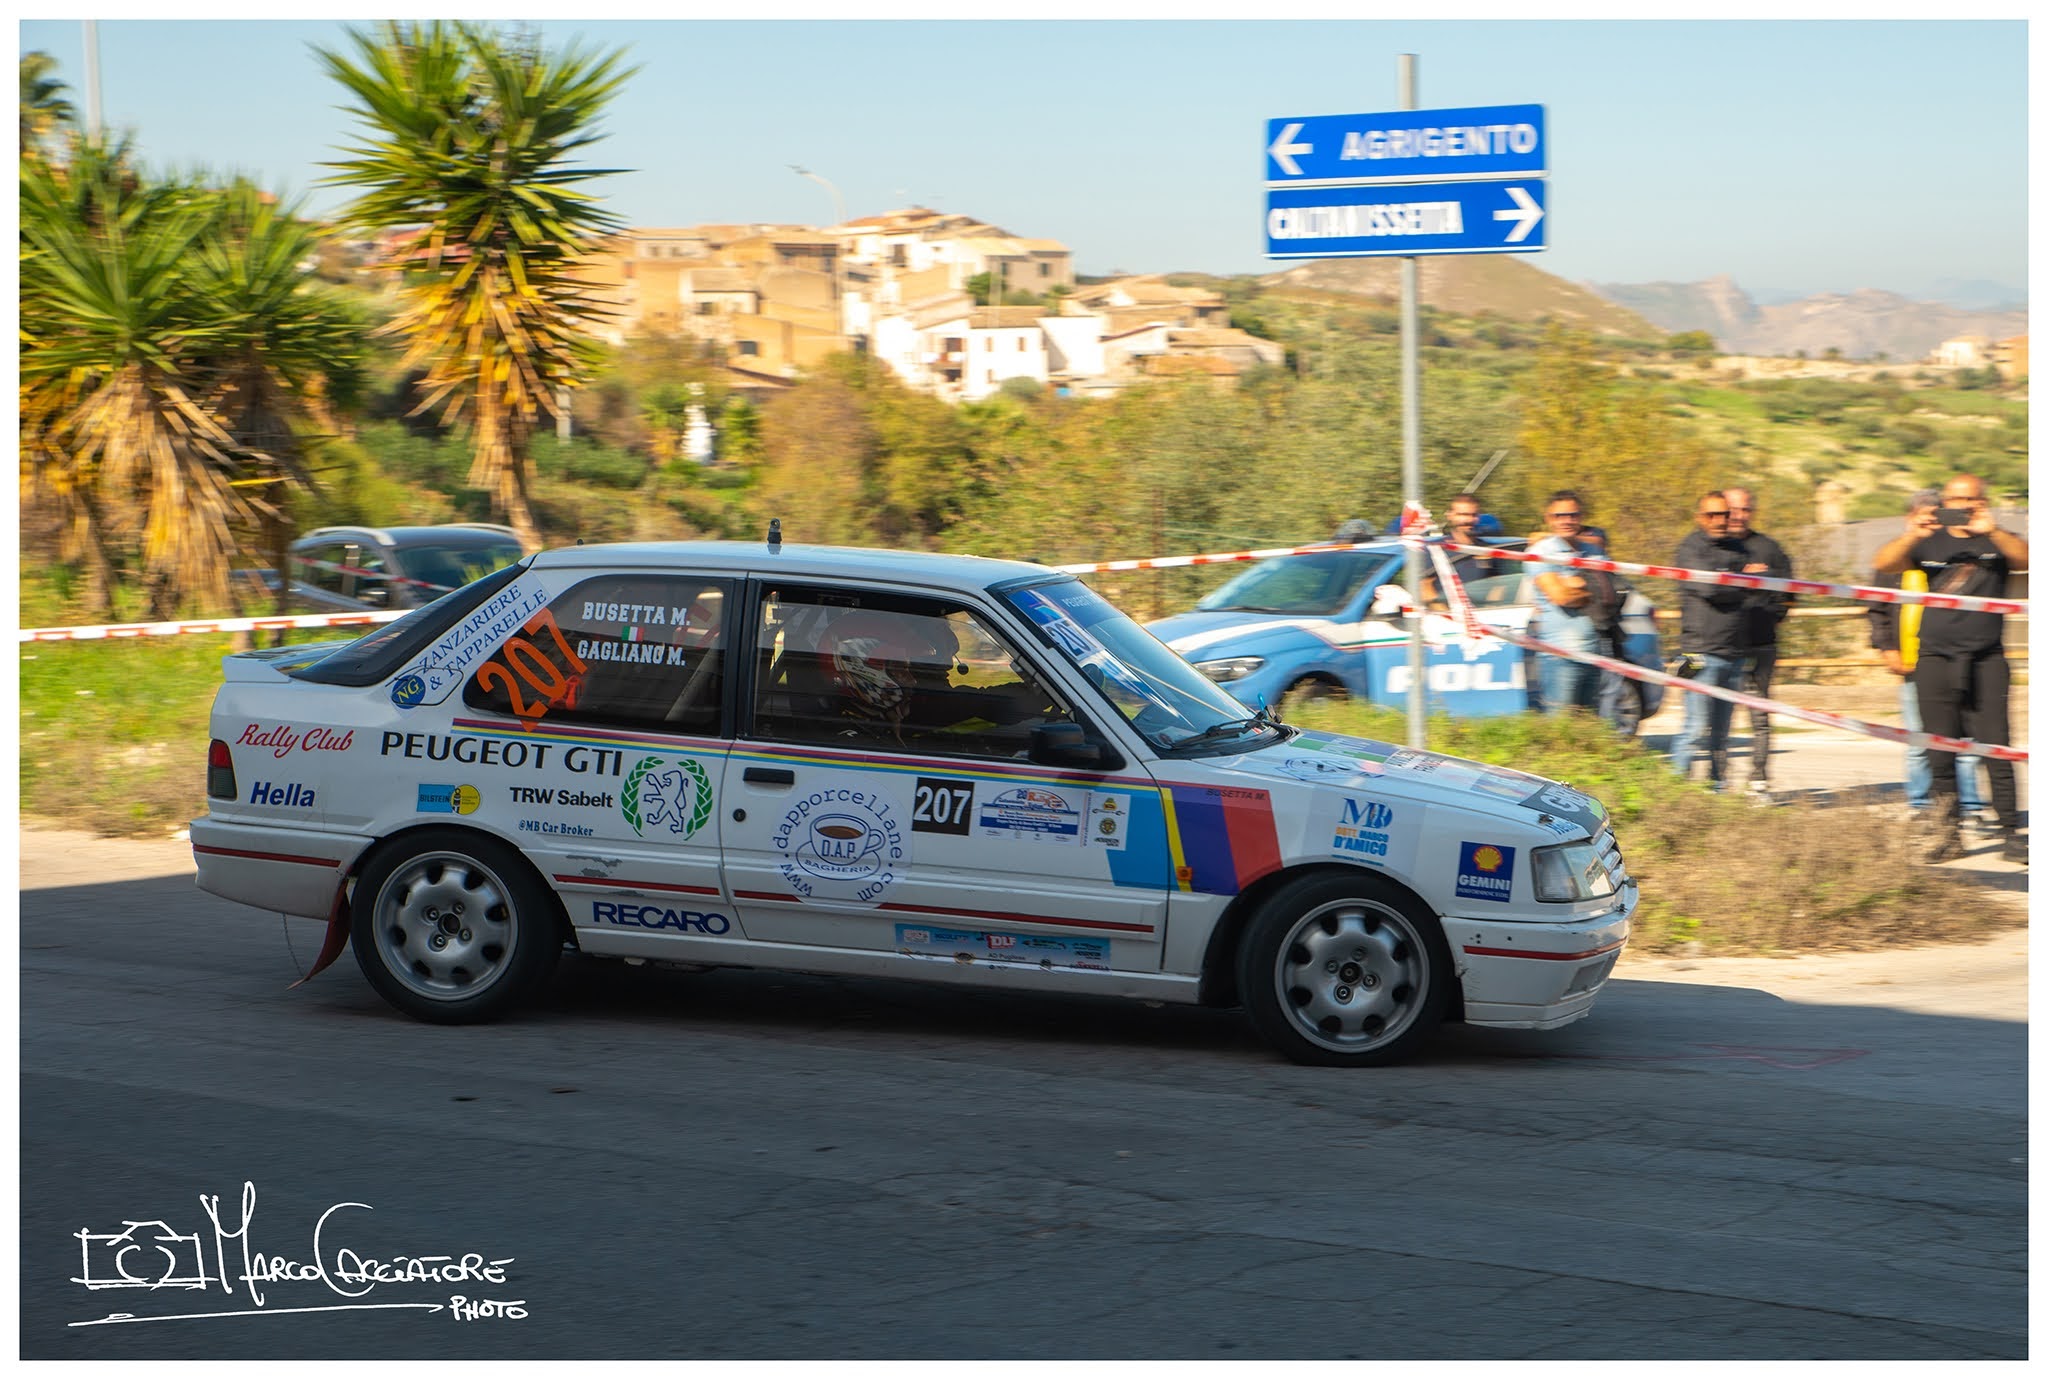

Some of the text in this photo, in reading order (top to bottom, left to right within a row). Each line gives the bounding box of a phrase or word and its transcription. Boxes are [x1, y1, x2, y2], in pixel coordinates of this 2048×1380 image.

[1339, 122, 1538, 161] AGRIGENTO
[582, 601, 692, 627] BUSETTA M.
[418, 584, 523, 674] ZANZARIERE
[430, 588, 549, 690] & TAPPARELLE
[577, 639, 687, 667] GAGLIANO M.
[476, 606, 588, 733] 207
[396, 678, 419, 704] NG
[236, 722, 355, 758] Rally Club
[381, 731, 623, 777] PEUGEOT GTI
[250, 781, 316, 808] Hella
[509, 786, 614, 809] TRW Sabelt
[914, 785, 973, 826] 207
[518, 819, 594, 837] @MB Car Broker
[821, 839, 857, 860] D.A.P.
[1333, 836, 1388, 857] D'AMICO
[804, 859, 872, 873] BAGHERIA
[1458, 874, 1511, 891] GEMINI
[593, 900, 730, 936] RECARO
